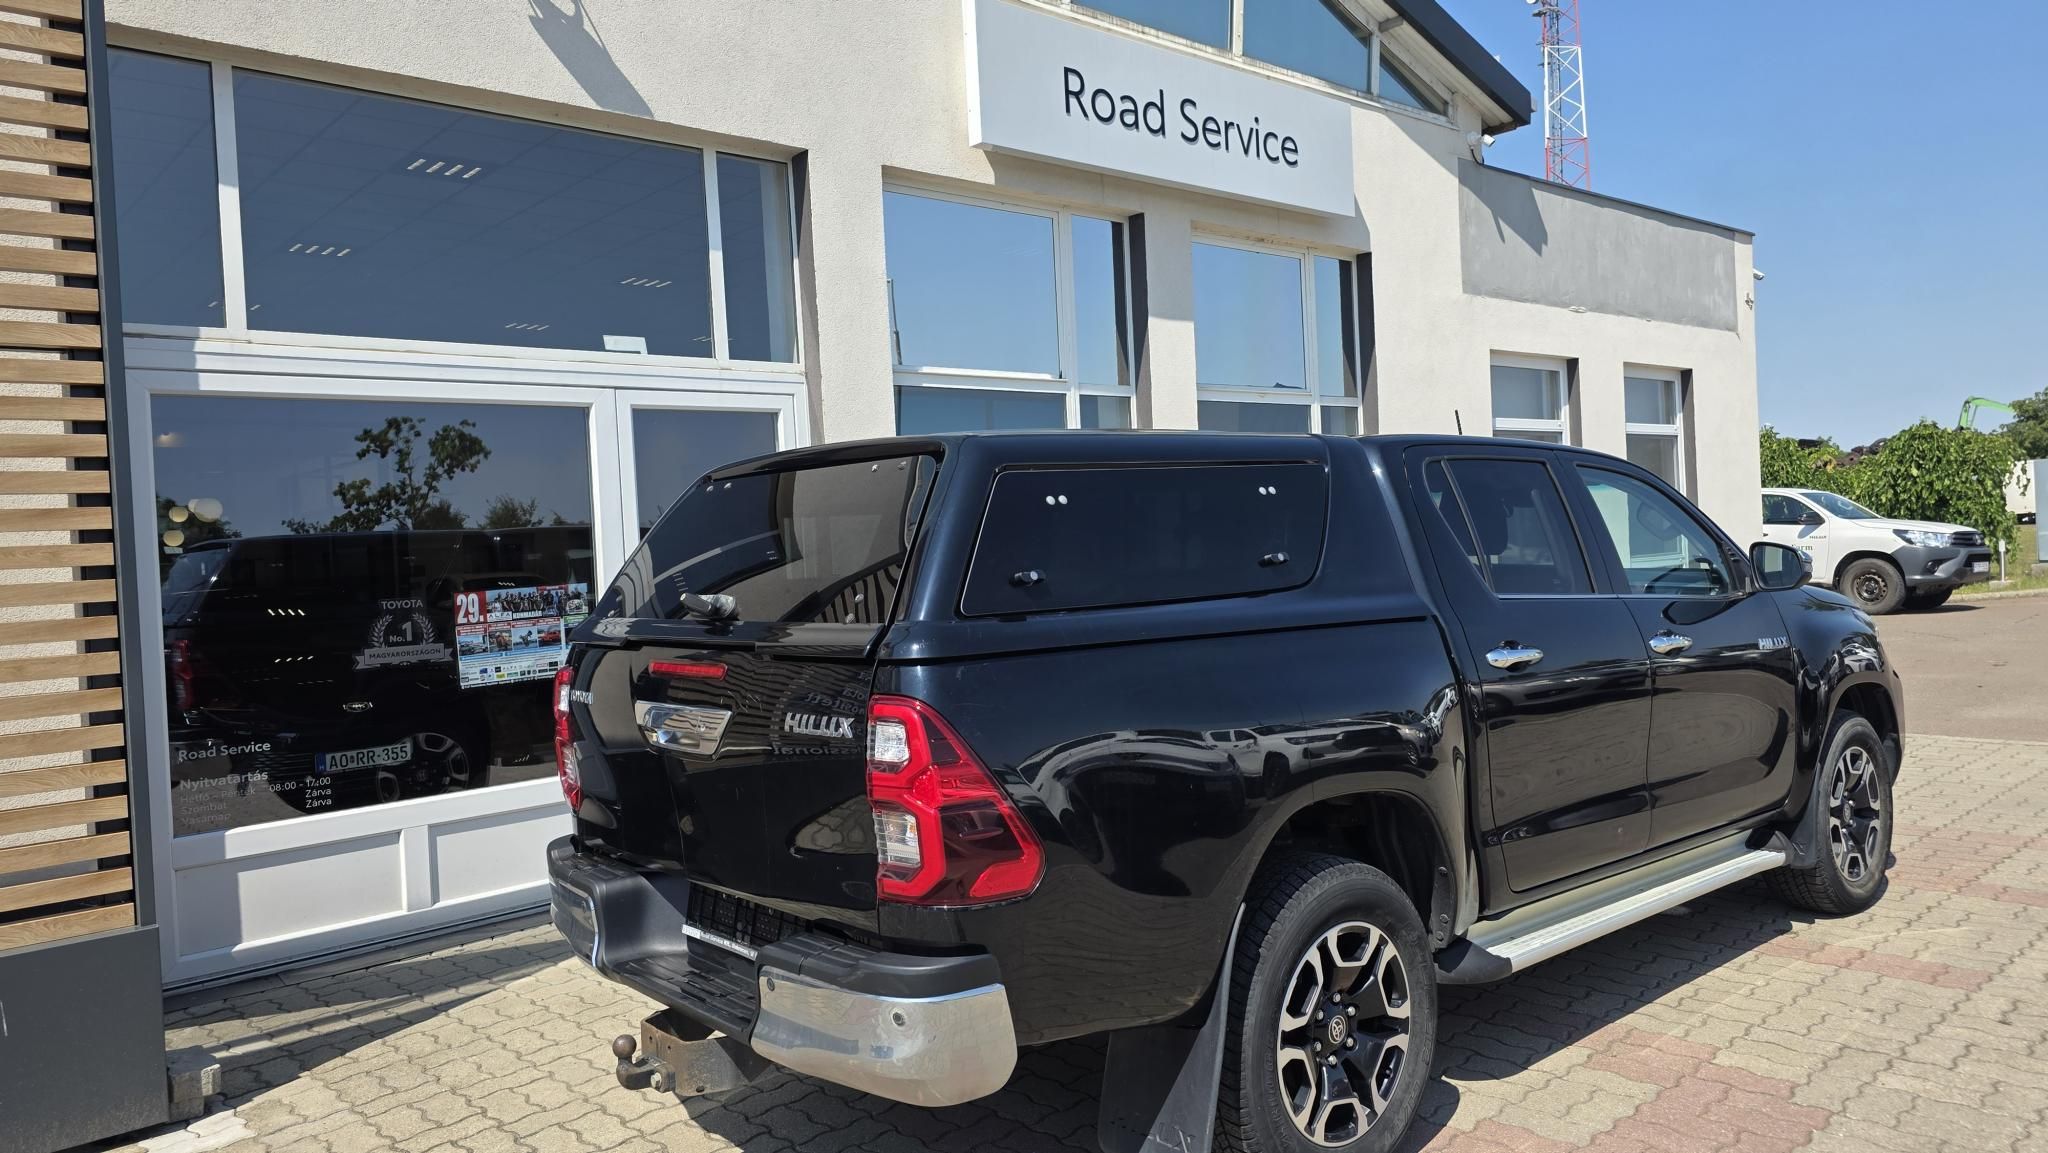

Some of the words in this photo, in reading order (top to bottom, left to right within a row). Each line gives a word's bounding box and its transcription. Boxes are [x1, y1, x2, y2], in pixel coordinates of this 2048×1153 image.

[1063, 66, 1166, 137] Road
[1180, 98, 1299, 167] Service
[381, 599, 424, 610] TOYOTA
[456, 593, 485, 624] 29.
[784, 712, 855, 738] HILUX
[178, 746, 216, 761] Road
[220, 741, 271, 756] Service
[180, 769, 269, 792] Nyitvatartás
[269, 781, 297, 793] 08:00
[305, 788, 332, 798] Zárva
[306, 798, 332, 808] Zárva
